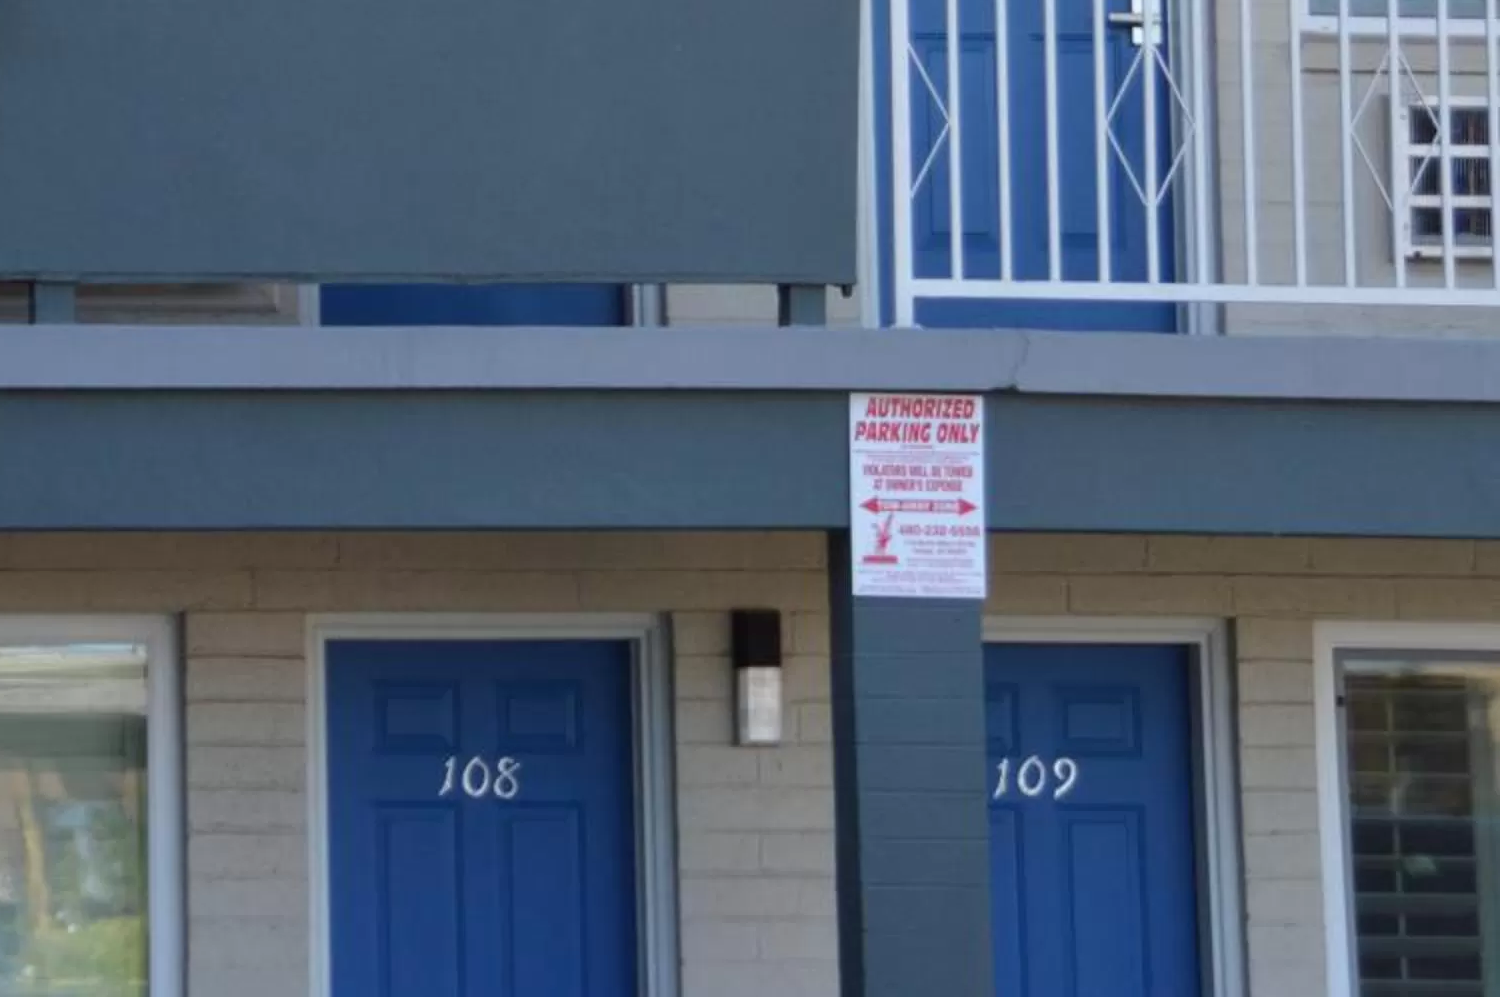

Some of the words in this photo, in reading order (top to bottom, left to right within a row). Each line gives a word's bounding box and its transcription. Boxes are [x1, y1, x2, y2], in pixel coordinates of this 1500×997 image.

[865, 396, 975, 419] AUTHORIZED
[854, 421, 931, 443] PARKING
[936, 423, 980, 444] ONLY
[439, 756, 521, 798] 108
[994, 756, 1077, 799] 109
